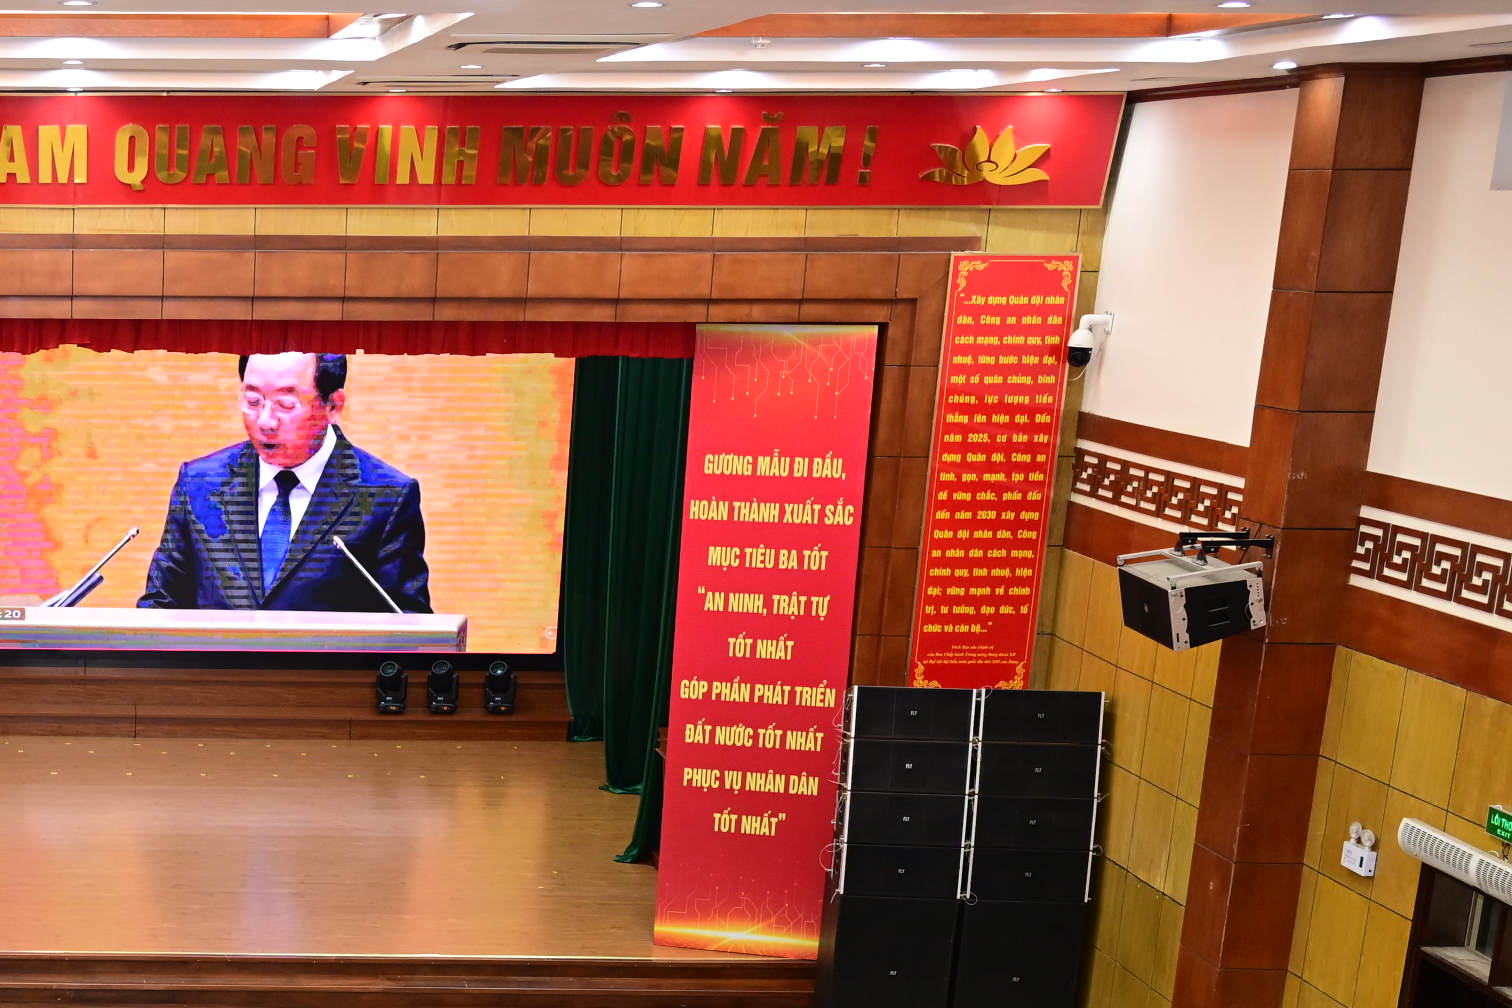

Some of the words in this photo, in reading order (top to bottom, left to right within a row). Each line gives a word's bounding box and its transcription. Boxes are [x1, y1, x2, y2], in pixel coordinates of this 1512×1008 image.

[113, 123, 319, 192] QUANG
[336, 124, 482, 186] VINH
[498, 111, 689, 187] MUÔN
[700, 111, 849, 188] NĂM
[704, 453, 752, 475] GƯƠNG
[757, 449, 789, 476] MẪU
[794, 457, 808, 477] ĐI
[813, 451, 846, 480] ĐẦU,
[690, 496, 728, 520] HOÀN
[733, 498, 779, 523] THÀNH
[783, 497, 821, 524] XUẤT
[825, 497, 854, 526] SẮC
[708, 546, 740, 571] MỤC
[745, 544, 775, 568] TIÊU
[779, 550, 797, 569] BA
[803, 544, 828, 571] TỐT
[728, 593, 767, 616] NINH,
[772, 591, 807, 619] TRẬT
[811, 595, 830, 620] TỰ
[728, 632, 753, 658] TỐT
[756, 634, 794, 660] NHẤT
[680, 676, 708, 699] GÓP
[712, 676, 750, 702] PHẦN
[754, 681, 791, 705] PHÁT
[795, 680, 836, 707] TRIỂN
[685, 718, 712, 744] ĐẤT
[715, 723, 753, 747] NƯỚC
[758, 723, 783, 748] TỐT
[786, 725, 824, 752] NHẤT
[683, 767, 720, 791] PHỤC
[725, 770, 741, 794] VỤ
[746, 770, 785, 793] NHÂN
[789, 772, 818, 795] DÂN
[713, 808, 738, 832] TỐT
[1497, 829, 1511, 838] EXIT
